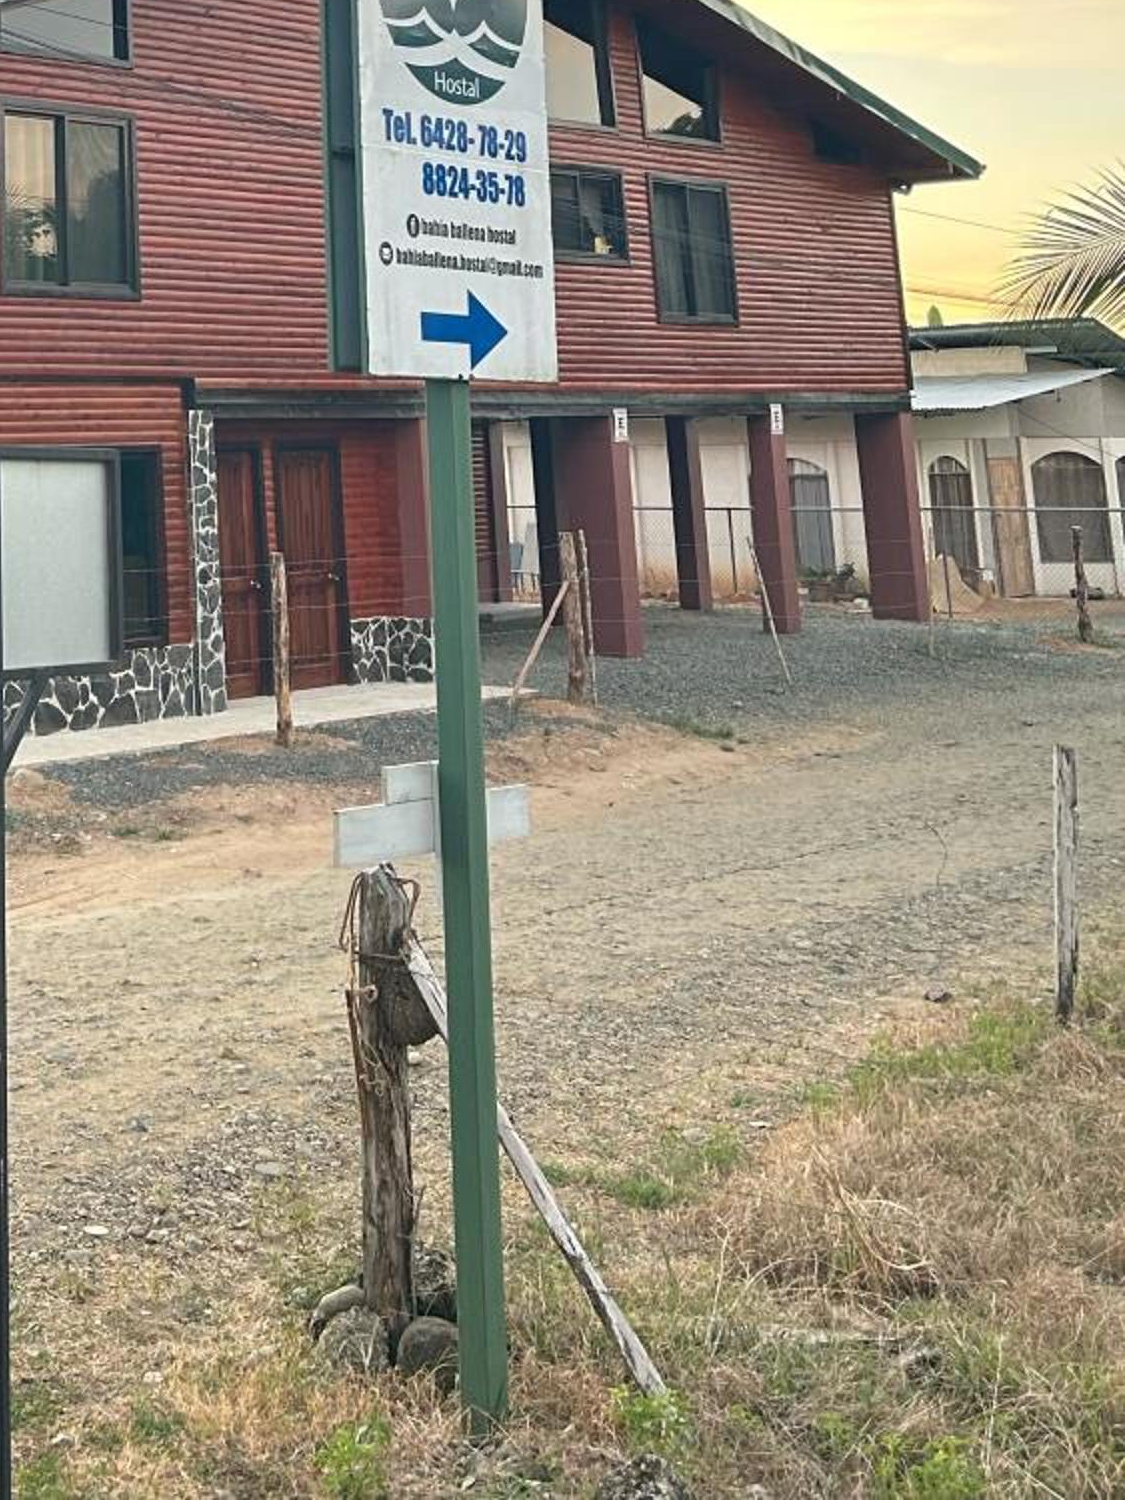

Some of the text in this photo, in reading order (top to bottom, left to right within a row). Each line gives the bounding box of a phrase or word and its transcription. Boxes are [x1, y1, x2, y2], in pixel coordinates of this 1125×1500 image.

[434, 71, 480, 98] Hostal
[382, 108, 417, 144] Tel.
[422, 162, 526, 207] 8824-35-78
[450, 223, 485, 241] ballena
[487, 226, 516, 244] hostal
